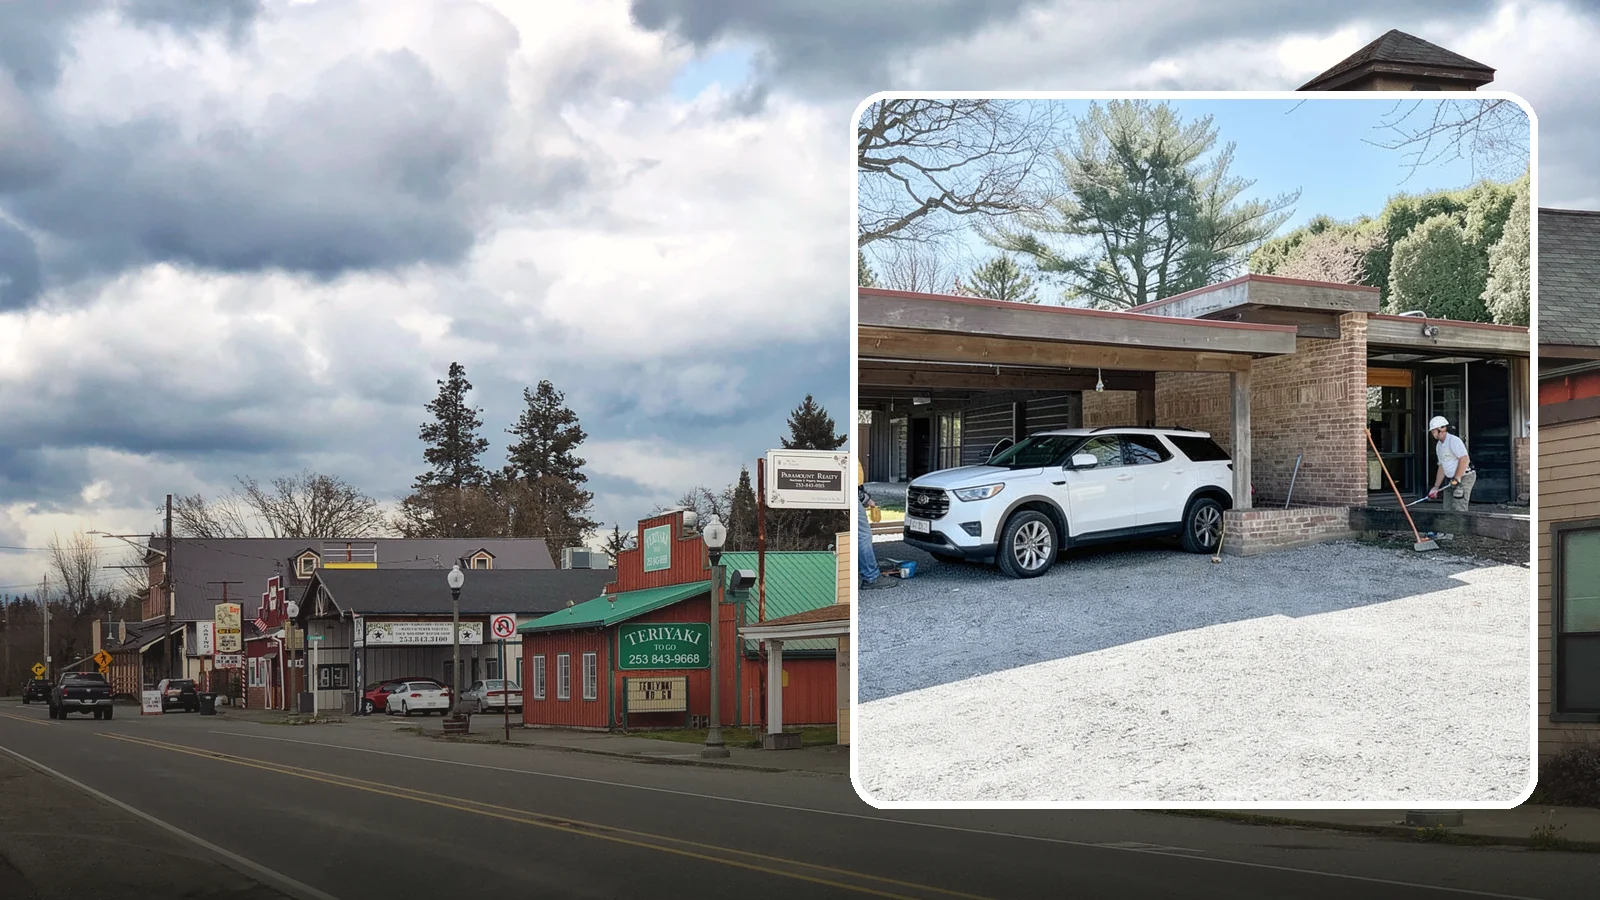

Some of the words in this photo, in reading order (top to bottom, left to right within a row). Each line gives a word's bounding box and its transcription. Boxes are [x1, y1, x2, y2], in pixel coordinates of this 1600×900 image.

[817, 472, 839, 480] REALTY
[624, 627, 702, 646] TERIYAKI
[628, 654, 648, 664] 253
[651, 654, 700, 664] 843-9668
